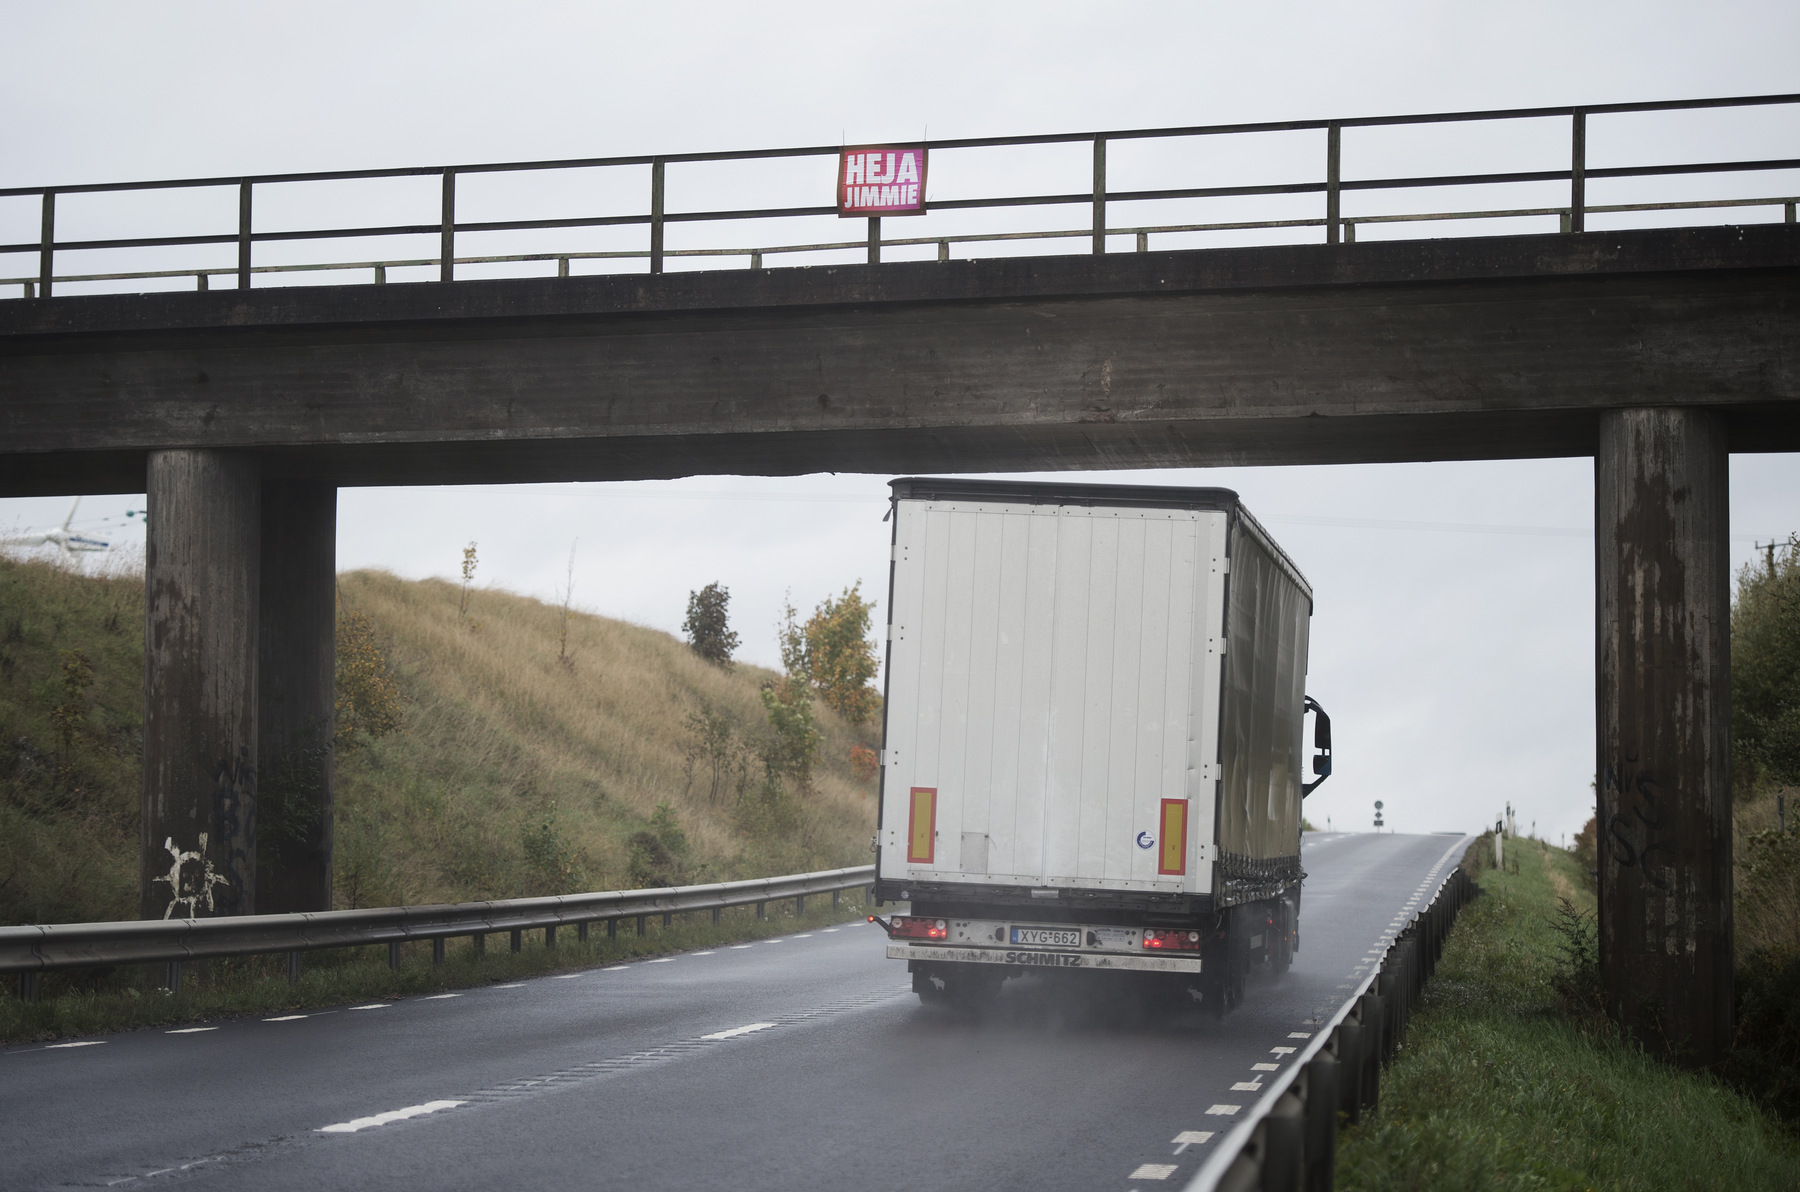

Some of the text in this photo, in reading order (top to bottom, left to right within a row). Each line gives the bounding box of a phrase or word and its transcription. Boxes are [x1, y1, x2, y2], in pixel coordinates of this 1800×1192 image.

[845, 153, 919, 185] HEJA
[844, 184, 918, 208] JIMMIE
[1021, 931, 1077, 944] XYG-662
[1005, 952, 1081, 966] SCHMITZ
